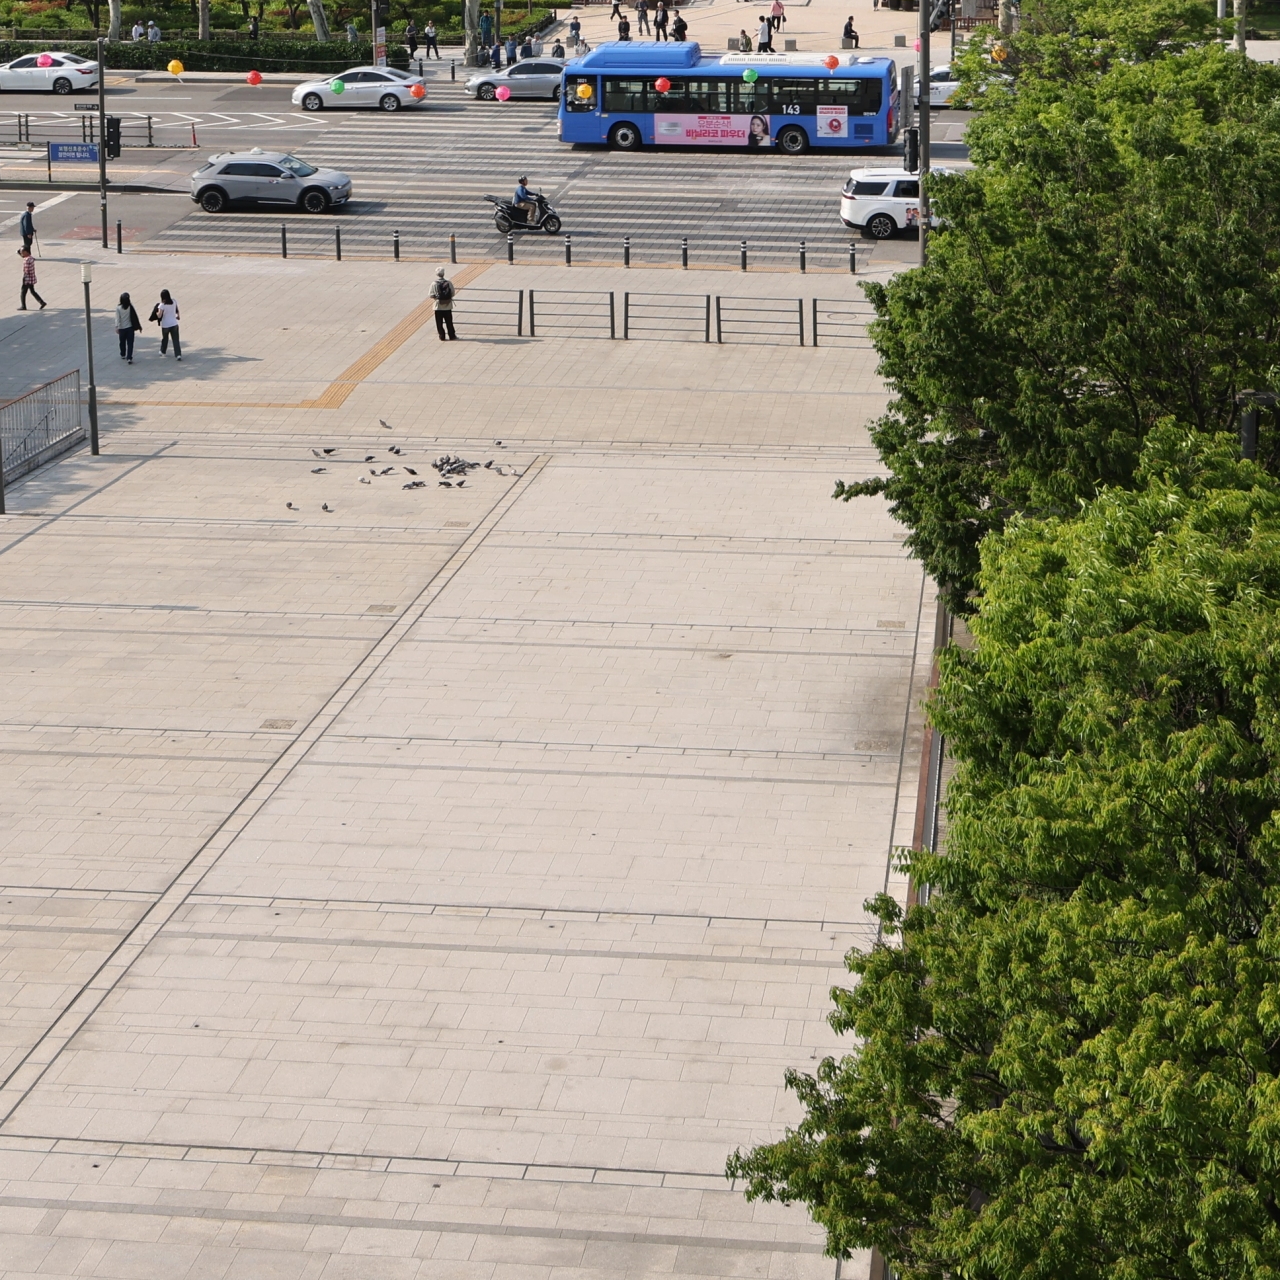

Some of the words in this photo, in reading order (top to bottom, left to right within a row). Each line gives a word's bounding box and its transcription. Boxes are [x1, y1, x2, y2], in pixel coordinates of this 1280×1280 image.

[782, 105, 800, 115] 143
[686, 129, 719, 138] 바닐라코
[720, 130, 745, 138] 파우더
